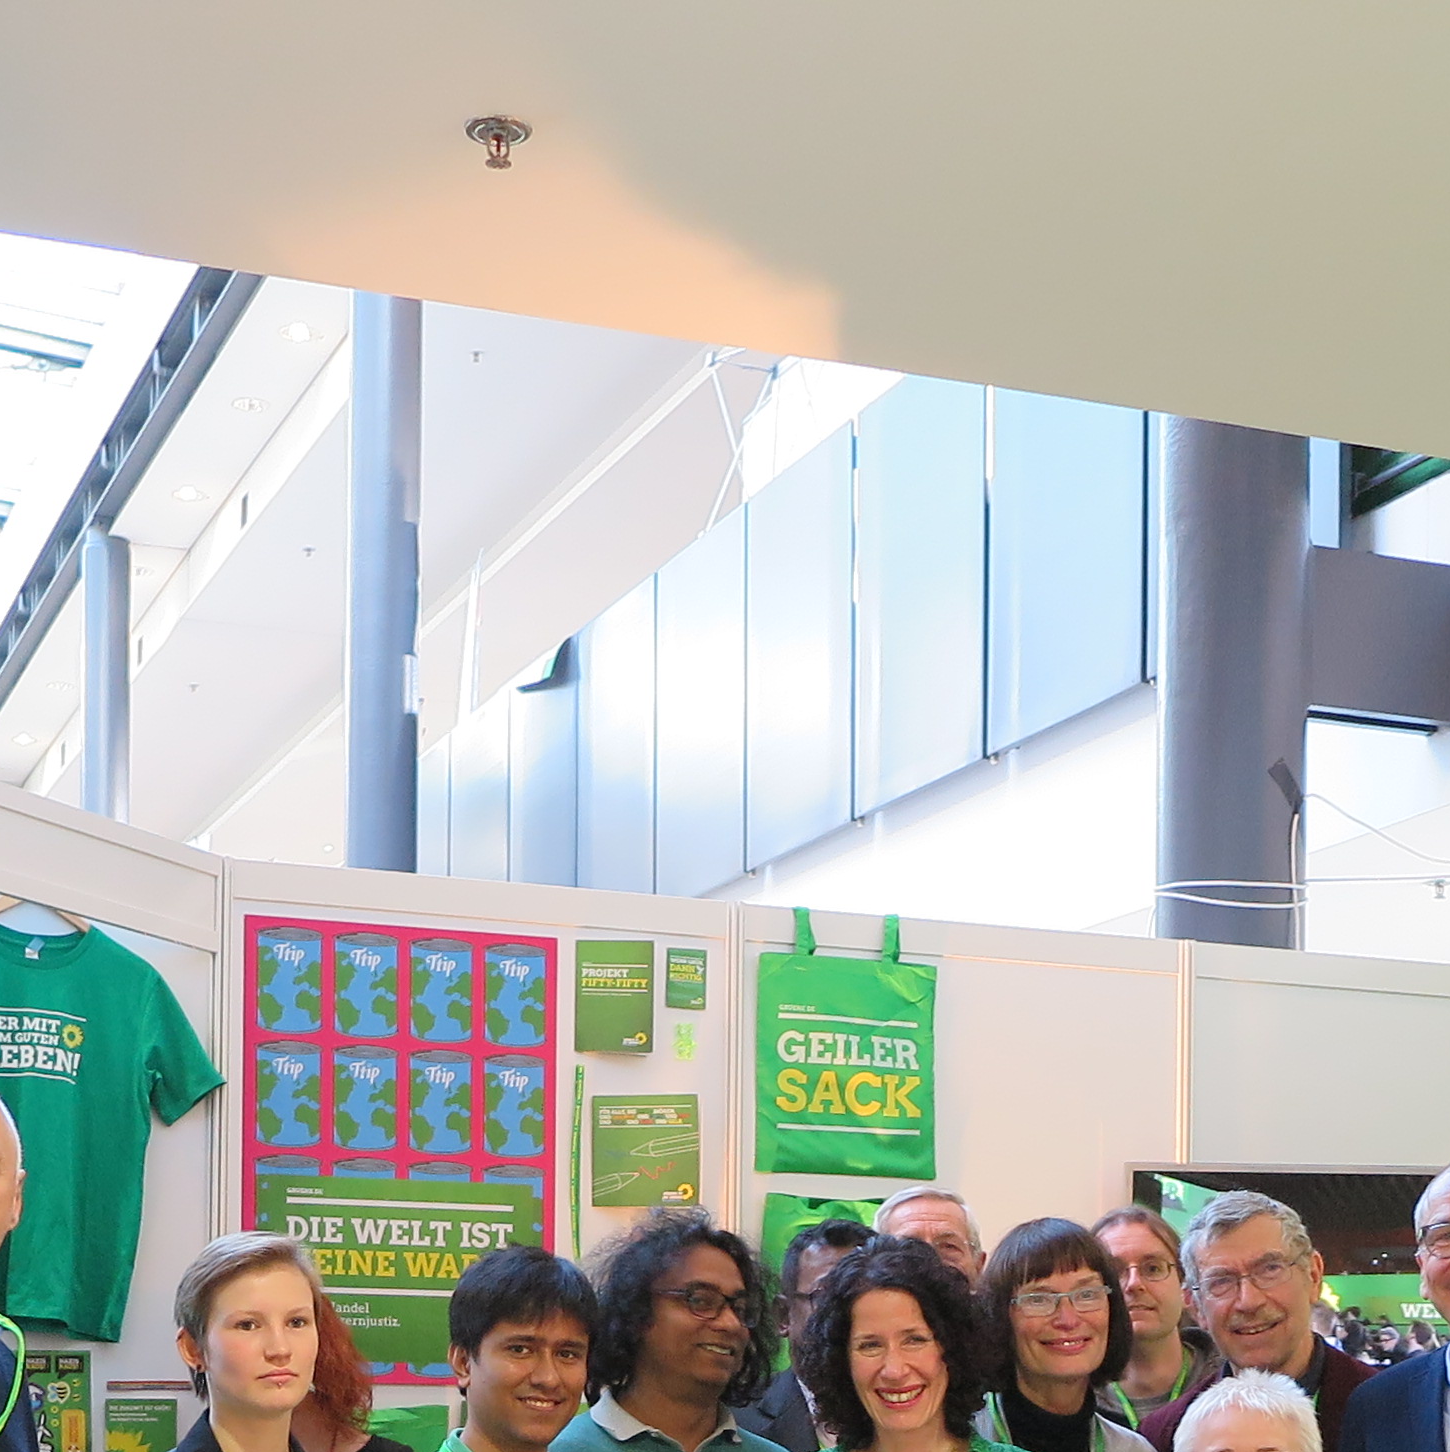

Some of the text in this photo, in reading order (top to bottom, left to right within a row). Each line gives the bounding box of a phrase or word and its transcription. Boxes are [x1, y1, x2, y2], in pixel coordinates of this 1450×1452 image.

[581, 968, 629, 978] PROJEKT
[581, 978, 648, 988] FIFTY-FIFTY
[22, 1016, 61, 1033] MIT
[14, 1032, 61, 1046] GUTEN
[777, 1030, 920, 1070] GEILER
[775, 1068, 922, 1118] SACK
[285, 1215, 514, 1250] DIE WELT IST
[315, 1249, 396, 1277] EINE
[332, 1302, 370, 1314] andel
